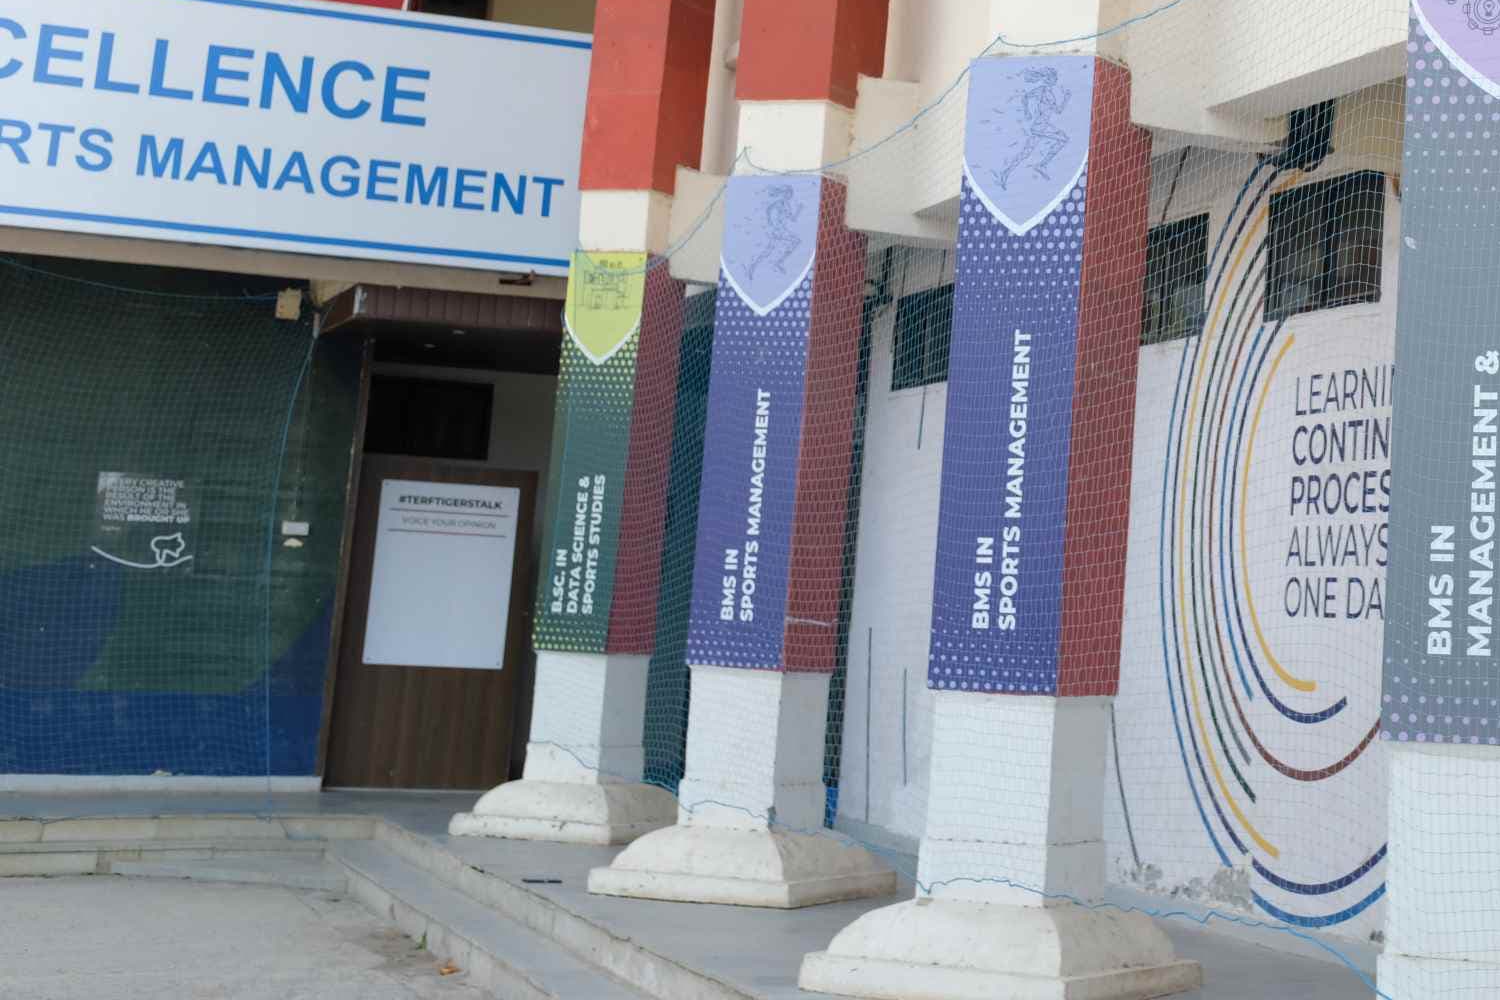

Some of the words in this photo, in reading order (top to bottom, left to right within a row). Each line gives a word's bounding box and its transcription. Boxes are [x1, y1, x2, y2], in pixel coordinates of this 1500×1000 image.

[135, 135, 566, 217] MANAGEMENT
[1474, 350, 1500, 375] &
[1004, 329, 1032, 518] MANAGEMENT
[578, 476, 590, 488] &
[747, 388, 772, 536] MANAGEMENT
[572, 491, 588, 563] SCIENCE
[588, 474, 606, 545] STUDIES
[1466, 384, 1498, 657] MANAGEMENT
[556, 549, 568, 568] IN
[724, 548, 740, 571] IN
[974, 537, 994, 564] IN
[1285, 522, 1389, 568] ALWAYS
[1430, 525, 1455, 562] IN
[566, 565, 582, 615] DATA
[581, 548, 599, 615] SPORTS
[720, 575, 737, 622] BMS
[740, 540, 760, 623] SPORTS
[971, 571, 992, 629] BMS
[998, 526, 1021, 630] SPORTS
[1284, 577, 1338, 619] ONE
[1427, 574, 1454, 655] BMS
